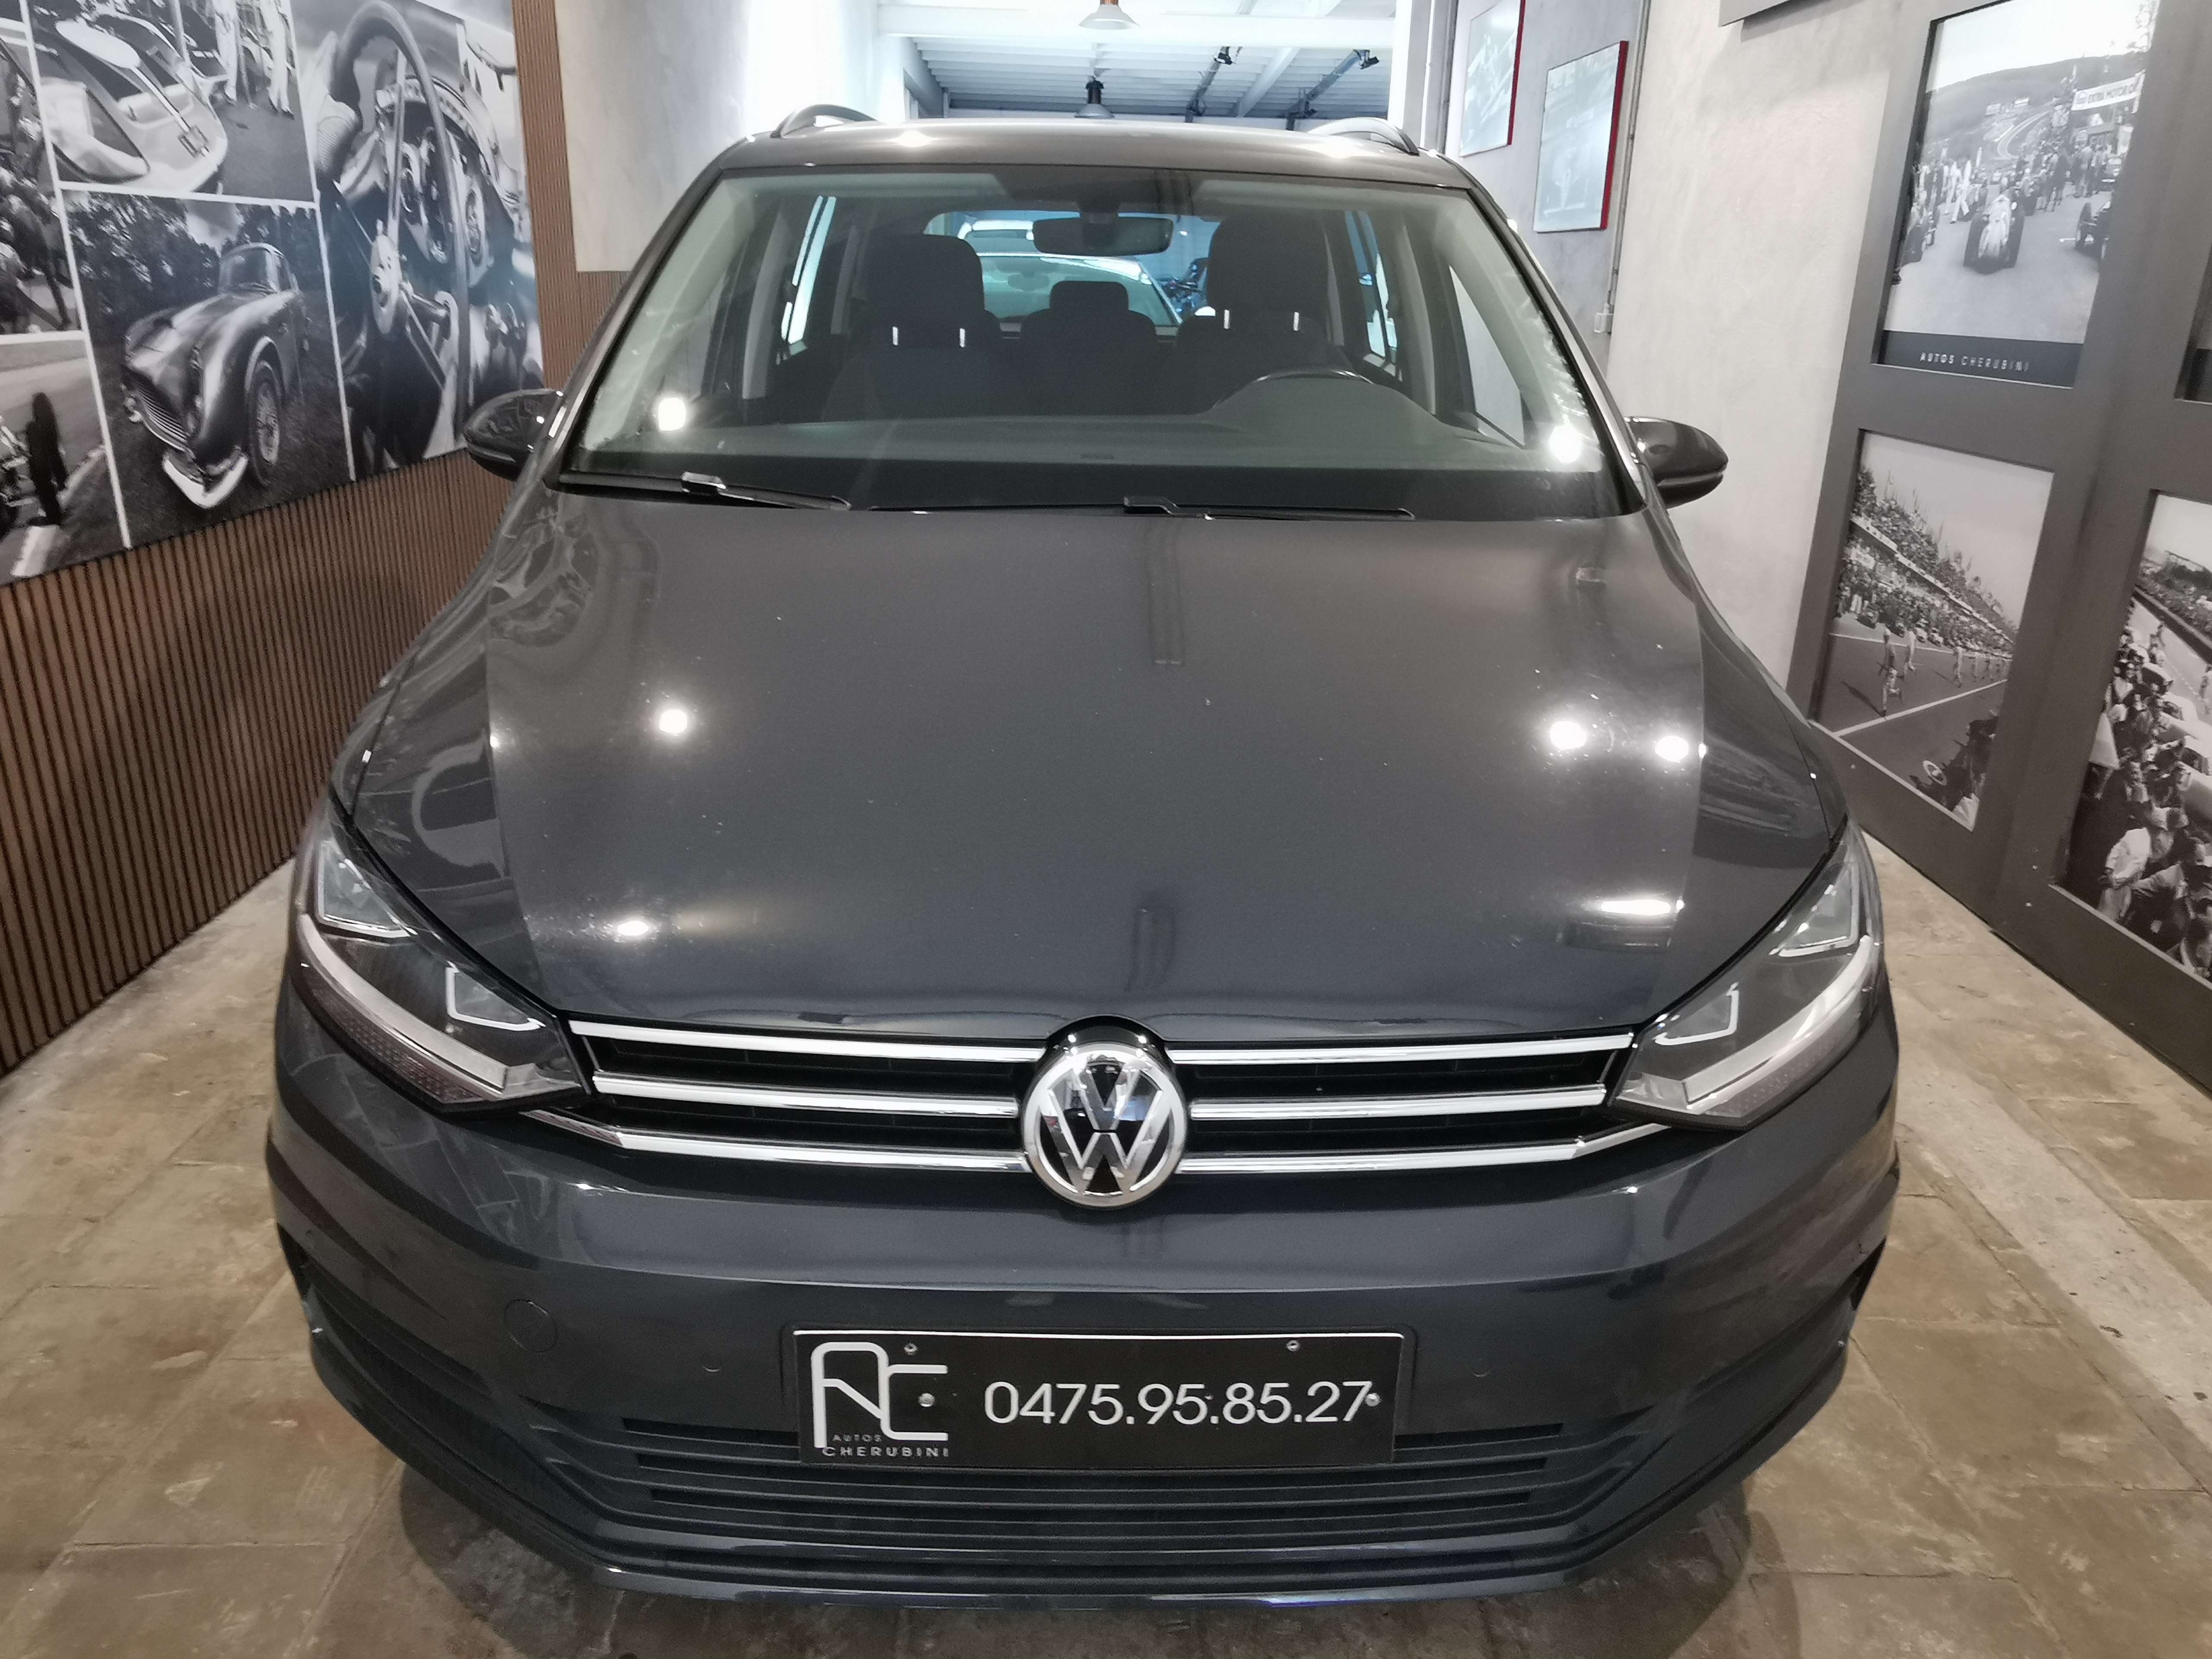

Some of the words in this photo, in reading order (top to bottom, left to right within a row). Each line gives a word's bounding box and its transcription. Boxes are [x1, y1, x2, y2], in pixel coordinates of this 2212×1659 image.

[1920, 351, 1955, 364] AUTOS
[1961, 356, 2029, 372] CHERUBINI
[1035, 1048, 1176, 1199] VW
[984, 1380, 1372, 1425] 0475.95.85.27
[832, 1434, 882, 1443] AUTOS
[822, 1446, 949, 1458] CHERUBINI
